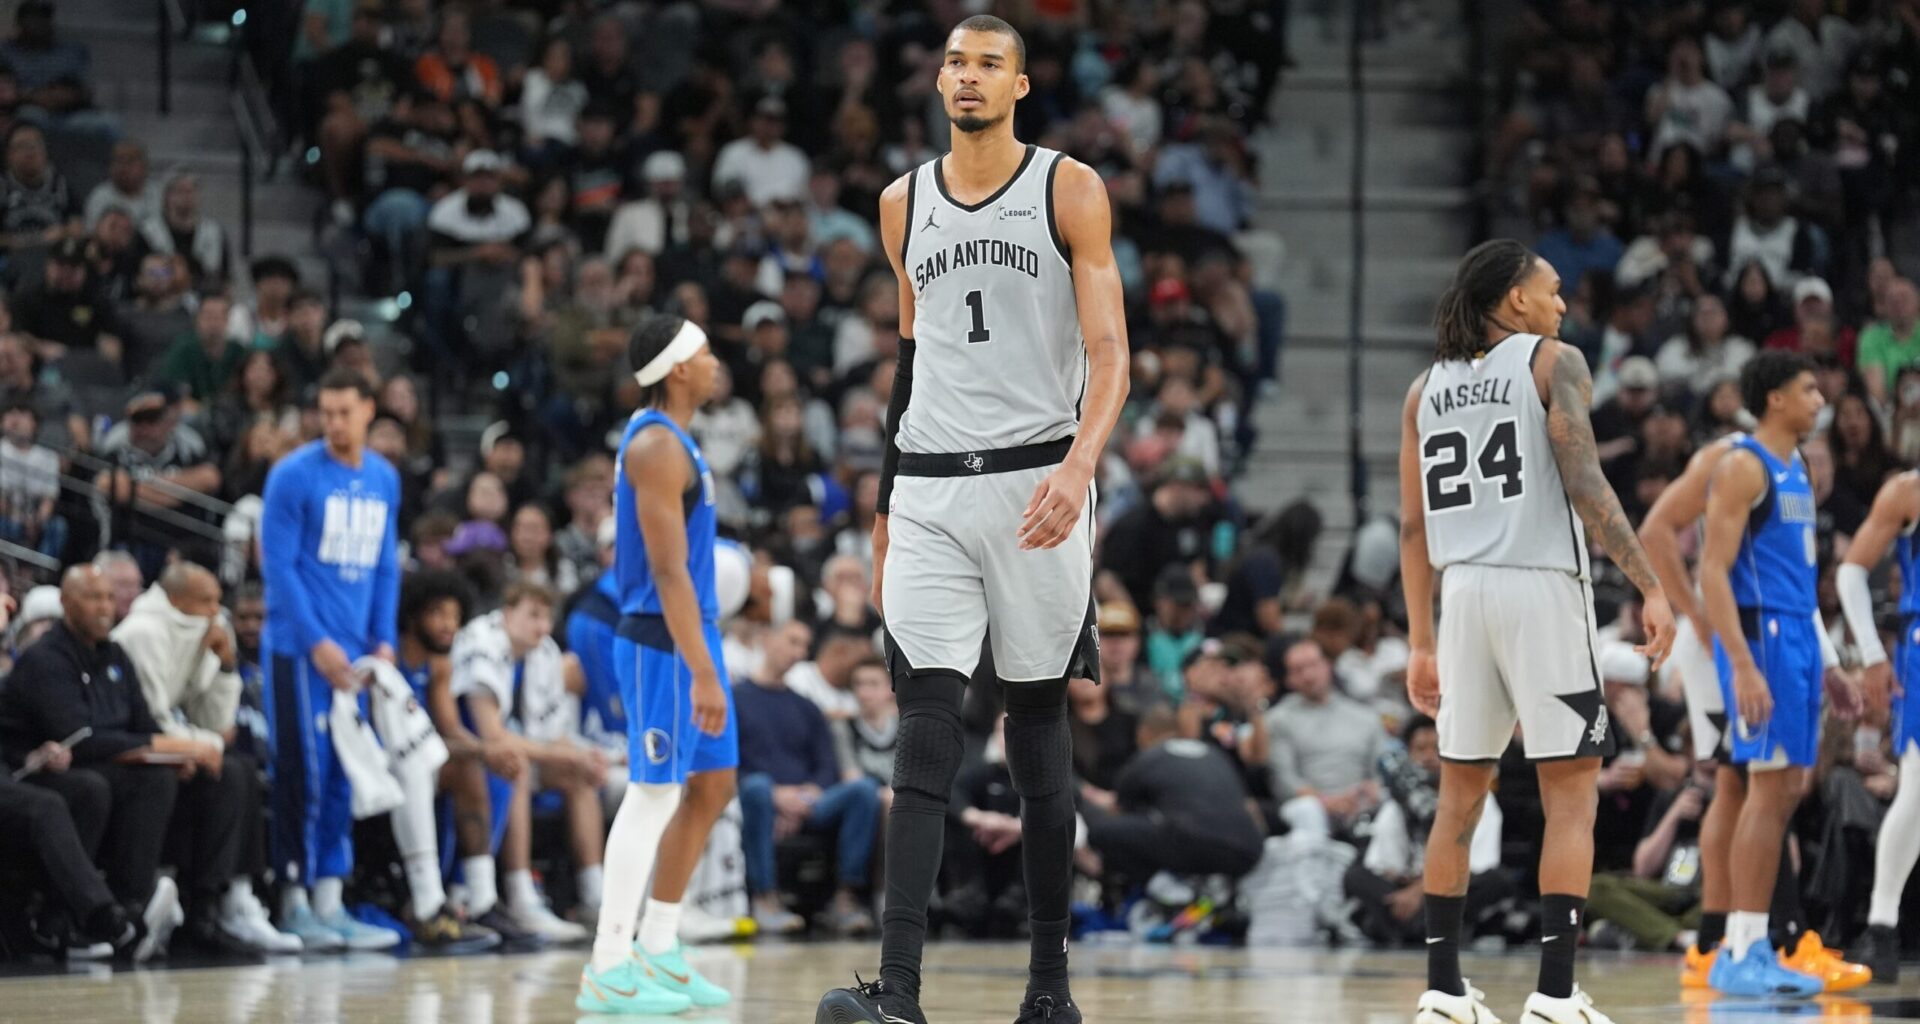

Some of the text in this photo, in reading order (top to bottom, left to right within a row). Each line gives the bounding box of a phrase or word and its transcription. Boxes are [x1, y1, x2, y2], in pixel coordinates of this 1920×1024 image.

[1003, 208, 1032, 217] LEDGER
[915, 239, 1039, 292] SAN ANTONIO
[965, 290, 990, 344] 1
[1430, 378, 1511, 417] VASSELL
[1423, 420, 1523, 512] 24
